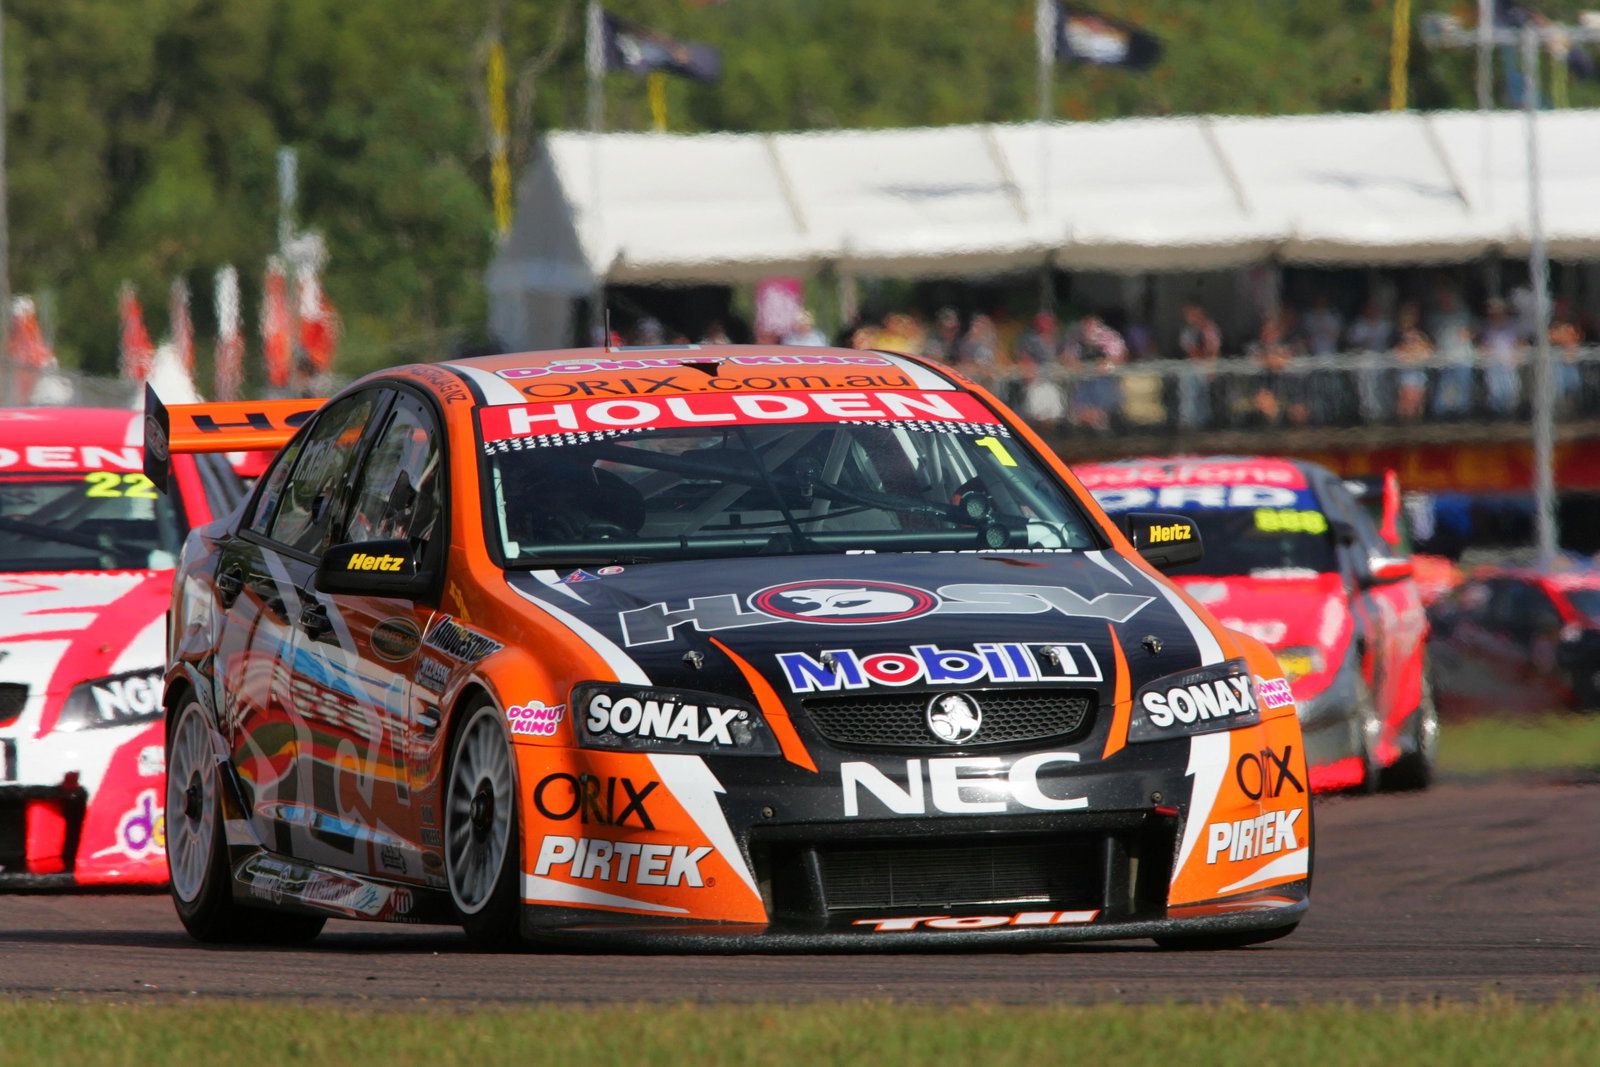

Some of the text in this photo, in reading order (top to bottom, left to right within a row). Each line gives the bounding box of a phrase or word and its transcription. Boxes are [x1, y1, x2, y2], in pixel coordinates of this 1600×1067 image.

[729, 354, 893, 368] KING
[522, 375, 909, 398] ORIX.com.au
[507, 391, 966, 435] HOLDEN
[974, 436, 1018, 467] 1
[84, 471, 159, 499] 22
[1149, 523, 1192, 543] Hertz
[346, 553, 405, 571] Hertz
[775, 643, 1034, 693] Mobil
[508, 704, 566, 720] DONUT
[1142, 675, 1257, 728] SONAX
[1263, 692, 1293, 707] KING
[513, 721, 556, 735] KING
[587, 694, 741, 745] SONAX
[840, 752, 1089, 817] NEC
[533, 772, 660, 831] ORIX
[1206, 808, 1303, 865] PIRTEK
[533, 834, 714, 888] PIRTEK
